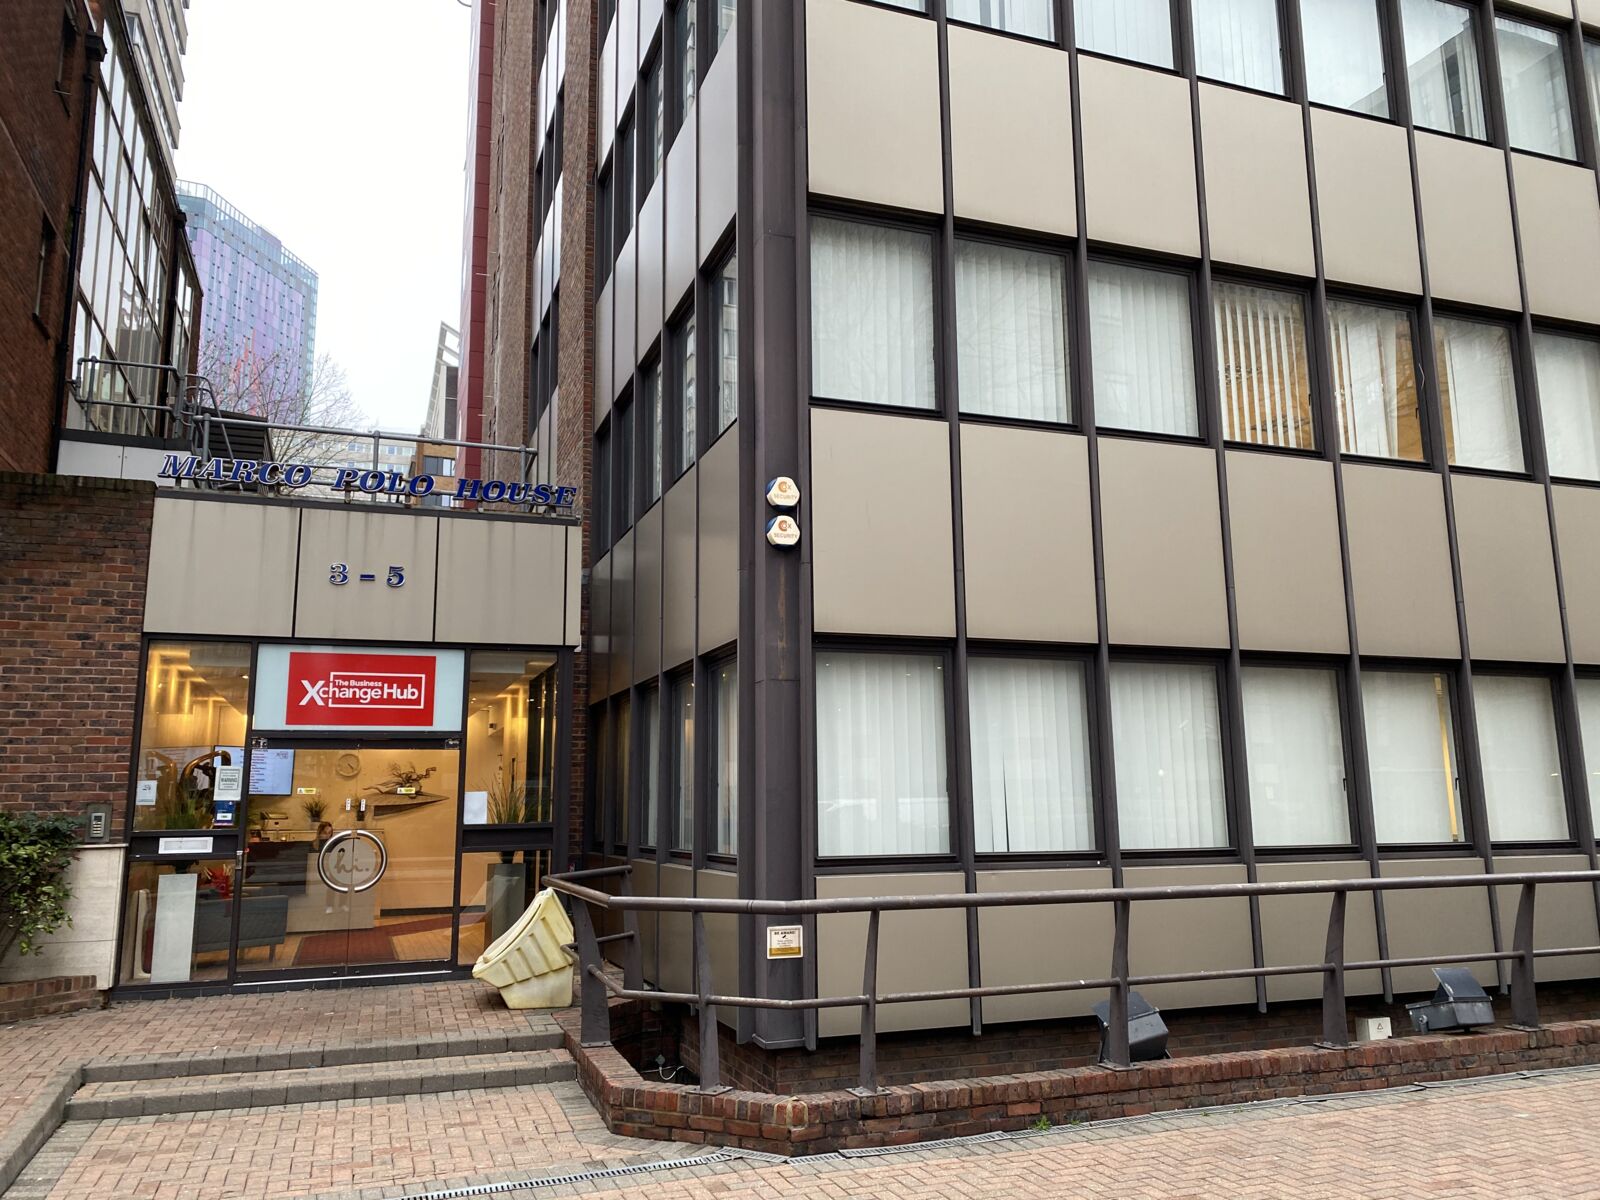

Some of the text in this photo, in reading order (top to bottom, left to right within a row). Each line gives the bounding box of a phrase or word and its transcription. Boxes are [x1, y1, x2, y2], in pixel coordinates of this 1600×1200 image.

[158, 453, 577, 507] MARCO POLO HOUSE
[298, 679, 419, 706] Xchange Hub
[334, 679, 349, 687] The
